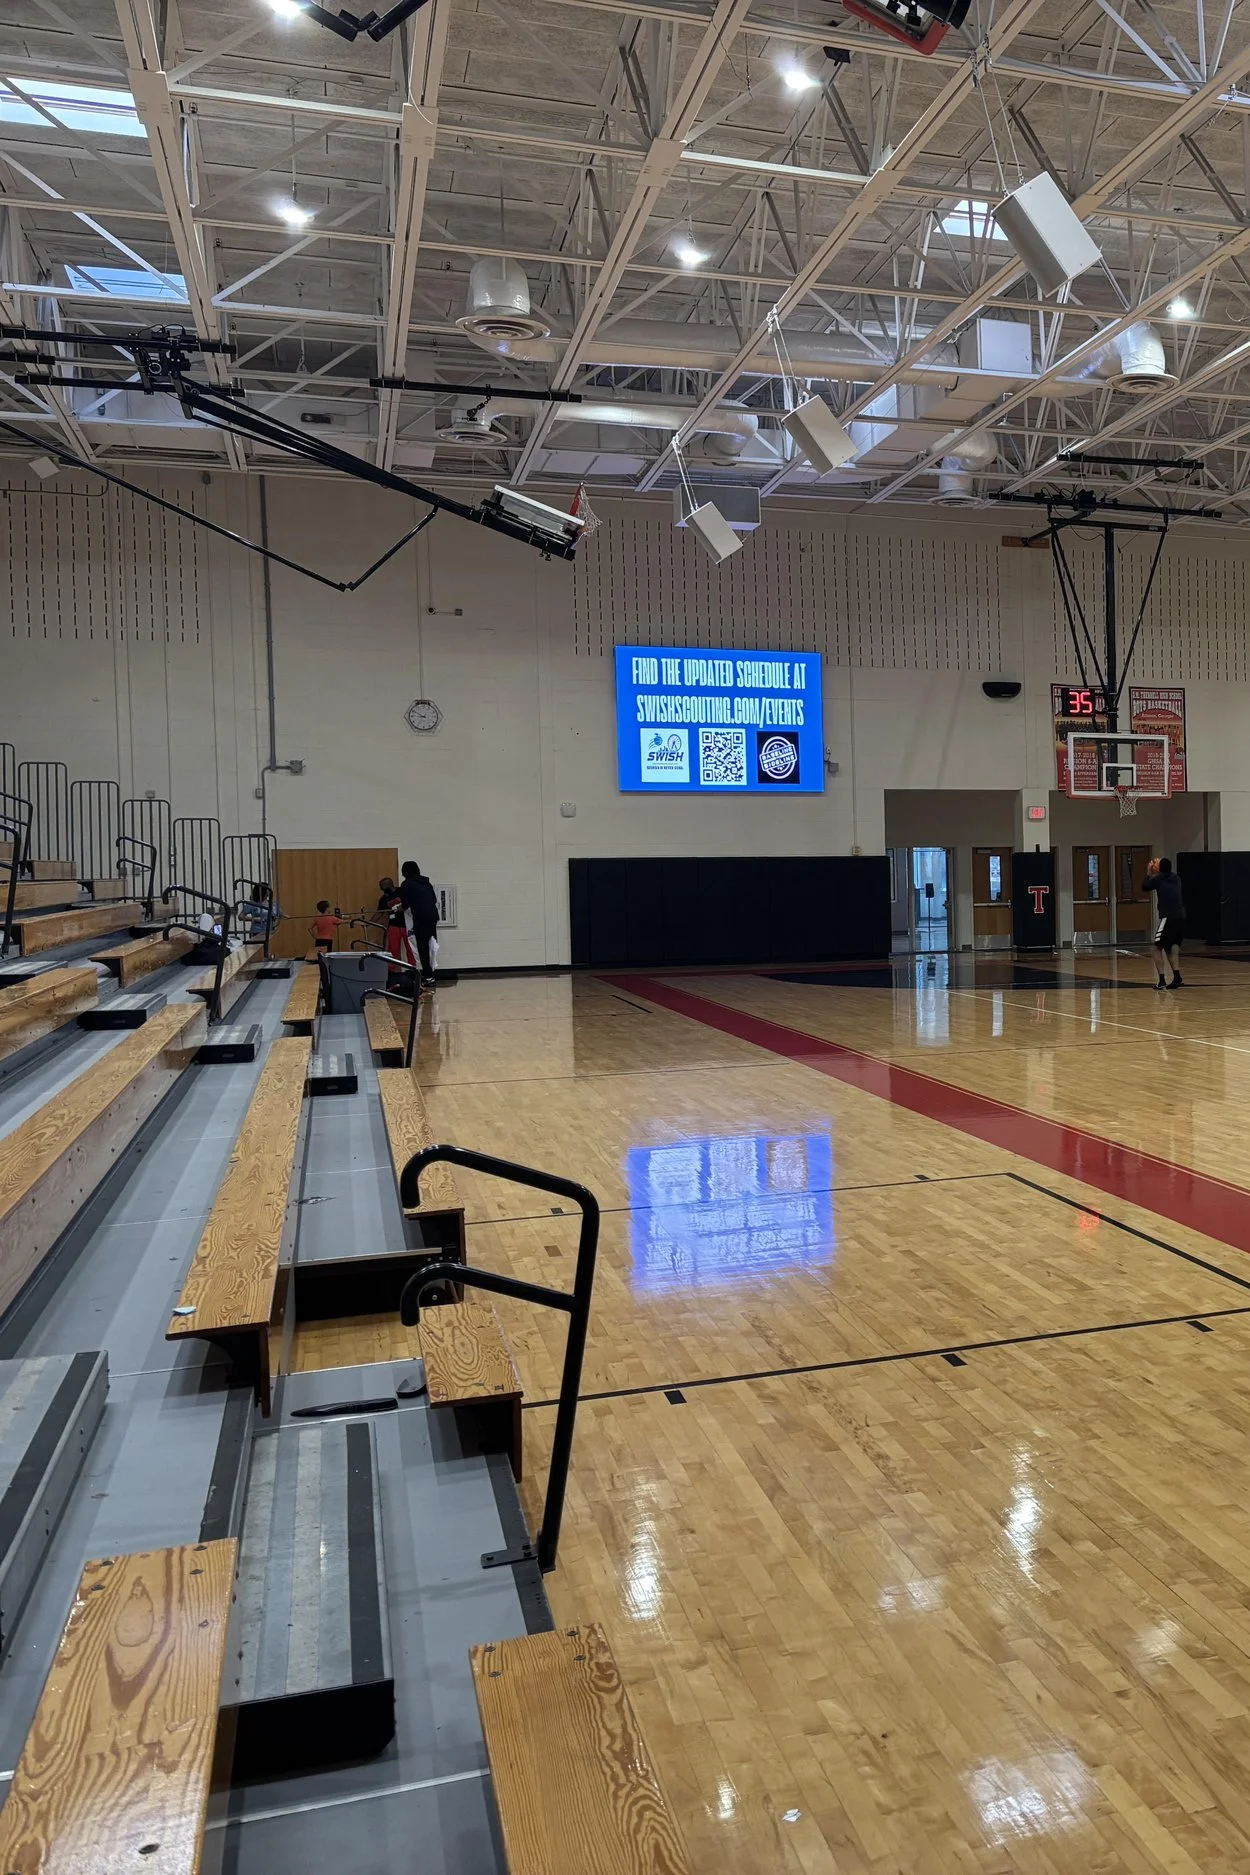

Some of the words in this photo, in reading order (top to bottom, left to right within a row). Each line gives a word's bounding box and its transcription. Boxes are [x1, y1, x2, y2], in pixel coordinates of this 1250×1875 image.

[632, 657, 658, 684] FIND
[661, 658, 681, 685] THE
[684, 659, 734, 687] UPDATED
[736, 661, 791, 689] SCHEDULE
[793, 663, 806, 689] AT
[637, 695, 804, 728] SWISHSCOUTING.COM/EVENTS
[1069, 692, 1092, 713] 35
[1147, 700, 1182, 718] BASKETBALL
[647, 752, 685, 762] SWISH
[1028, 885, 1049, 913] T
